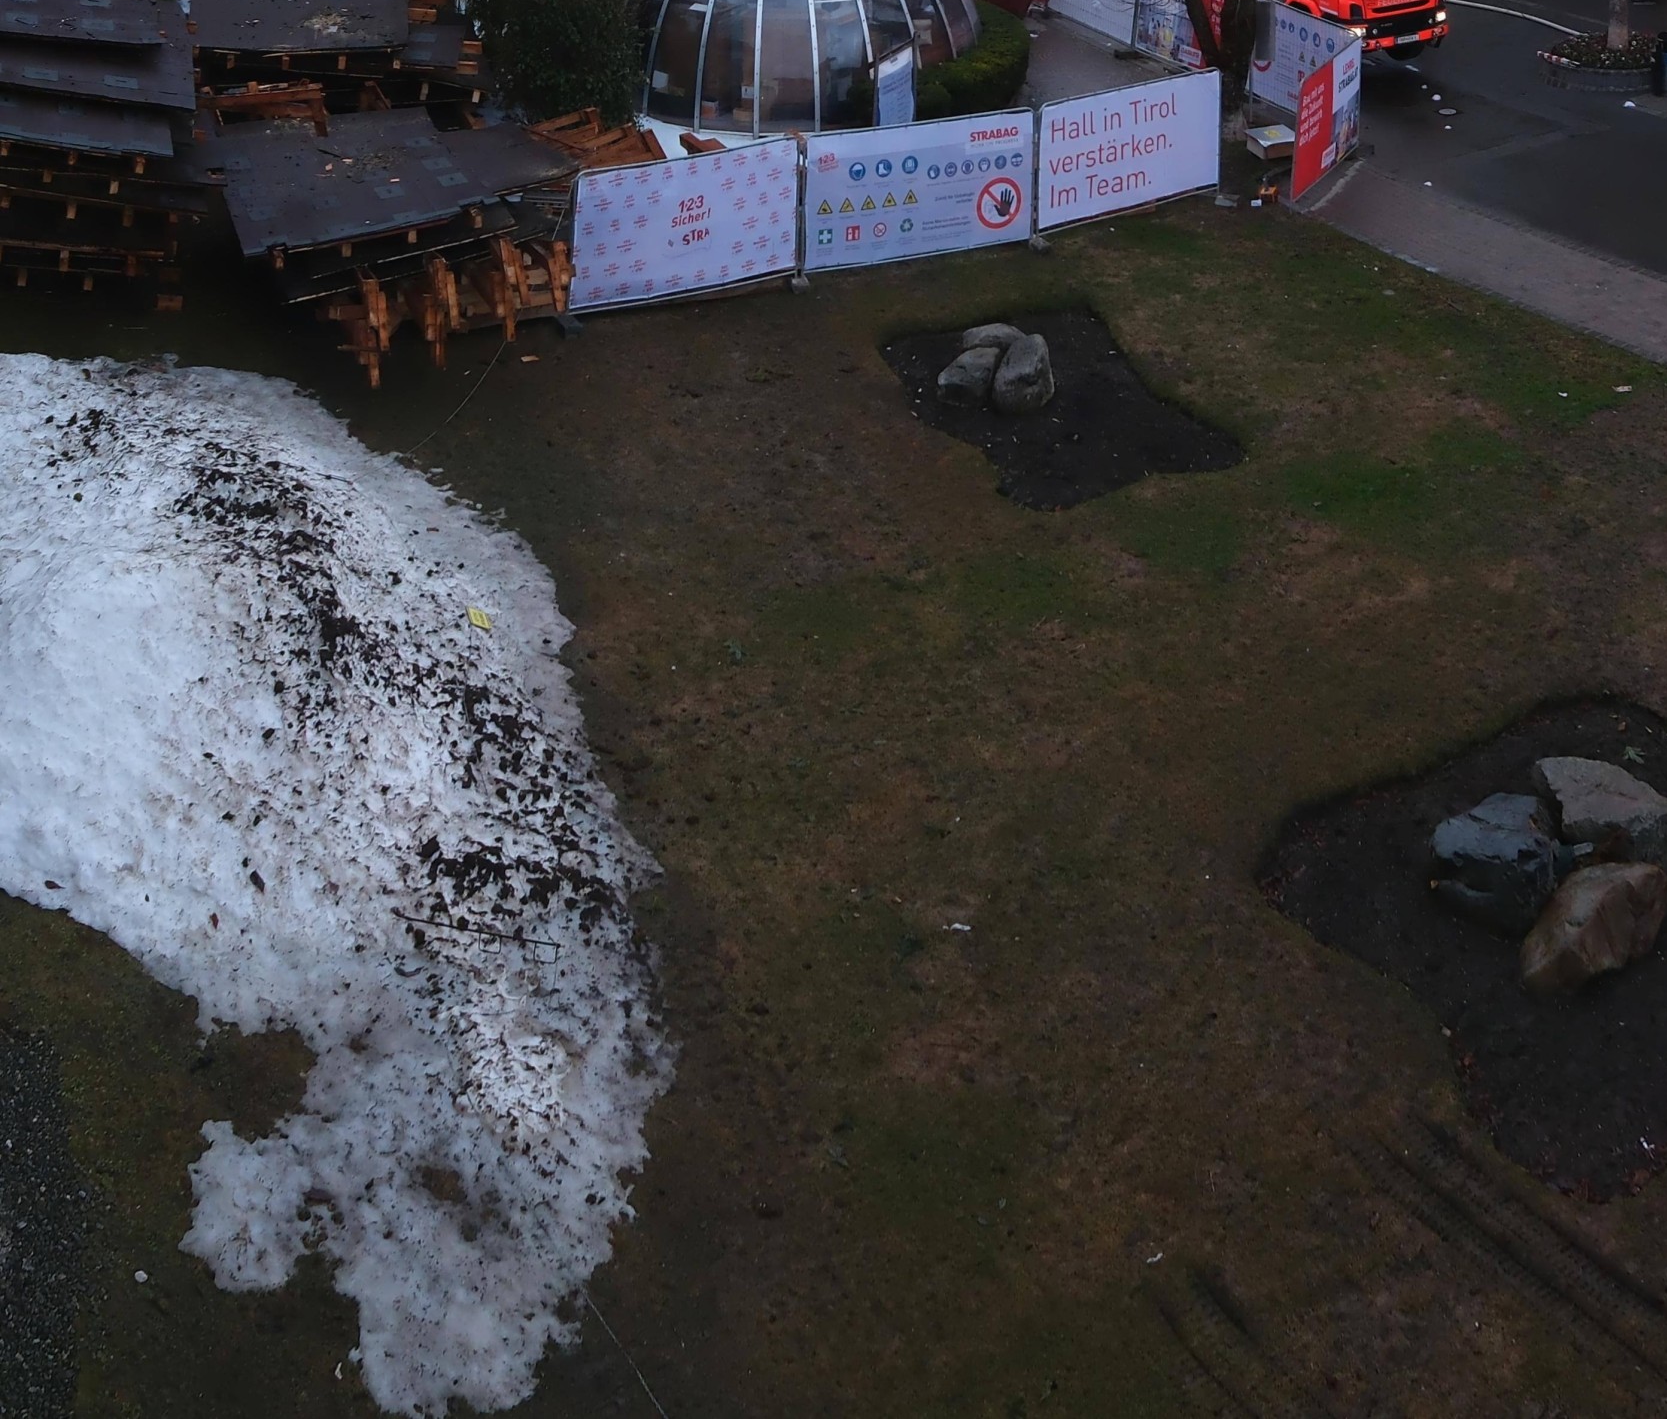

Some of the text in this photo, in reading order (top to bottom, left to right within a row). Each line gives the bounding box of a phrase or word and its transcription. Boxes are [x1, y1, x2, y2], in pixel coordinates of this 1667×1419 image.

[969, 126, 1019, 142] STRABAG
[1051, 92, 1177, 144] Hall in Tirol
[1049, 133, 1173, 176] verstärken.
[1050, 170, 1152, 209] Im Team.
[670, 207, 711, 229] Sicher!
